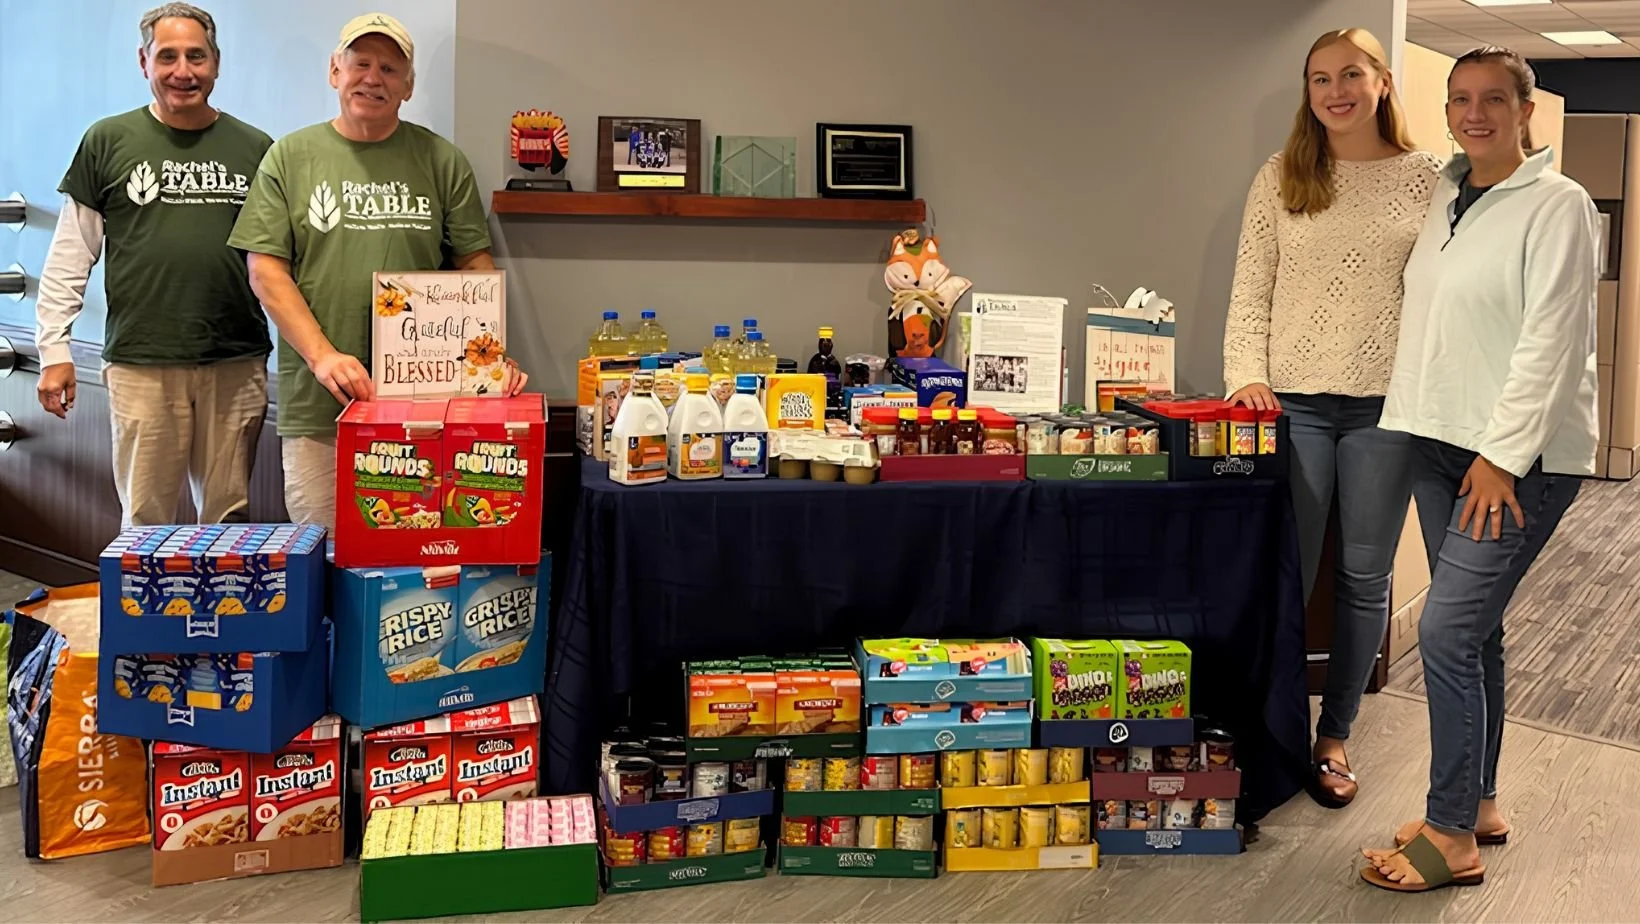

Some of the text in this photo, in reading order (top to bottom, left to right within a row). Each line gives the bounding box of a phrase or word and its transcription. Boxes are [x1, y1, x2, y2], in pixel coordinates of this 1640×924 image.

[162, 159, 228, 173] Rachel's
[161, 171, 249, 191] TABLE
[342, 180, 409, 195] Rachel's
[342, 193, 432, 216] TABLE
[383, 353, 456, 385] BLESSED
[380, 601, 453, 640] RISPY
[479, 608, 531, 640] RICE
[387, 619, 443, 655] RICE
